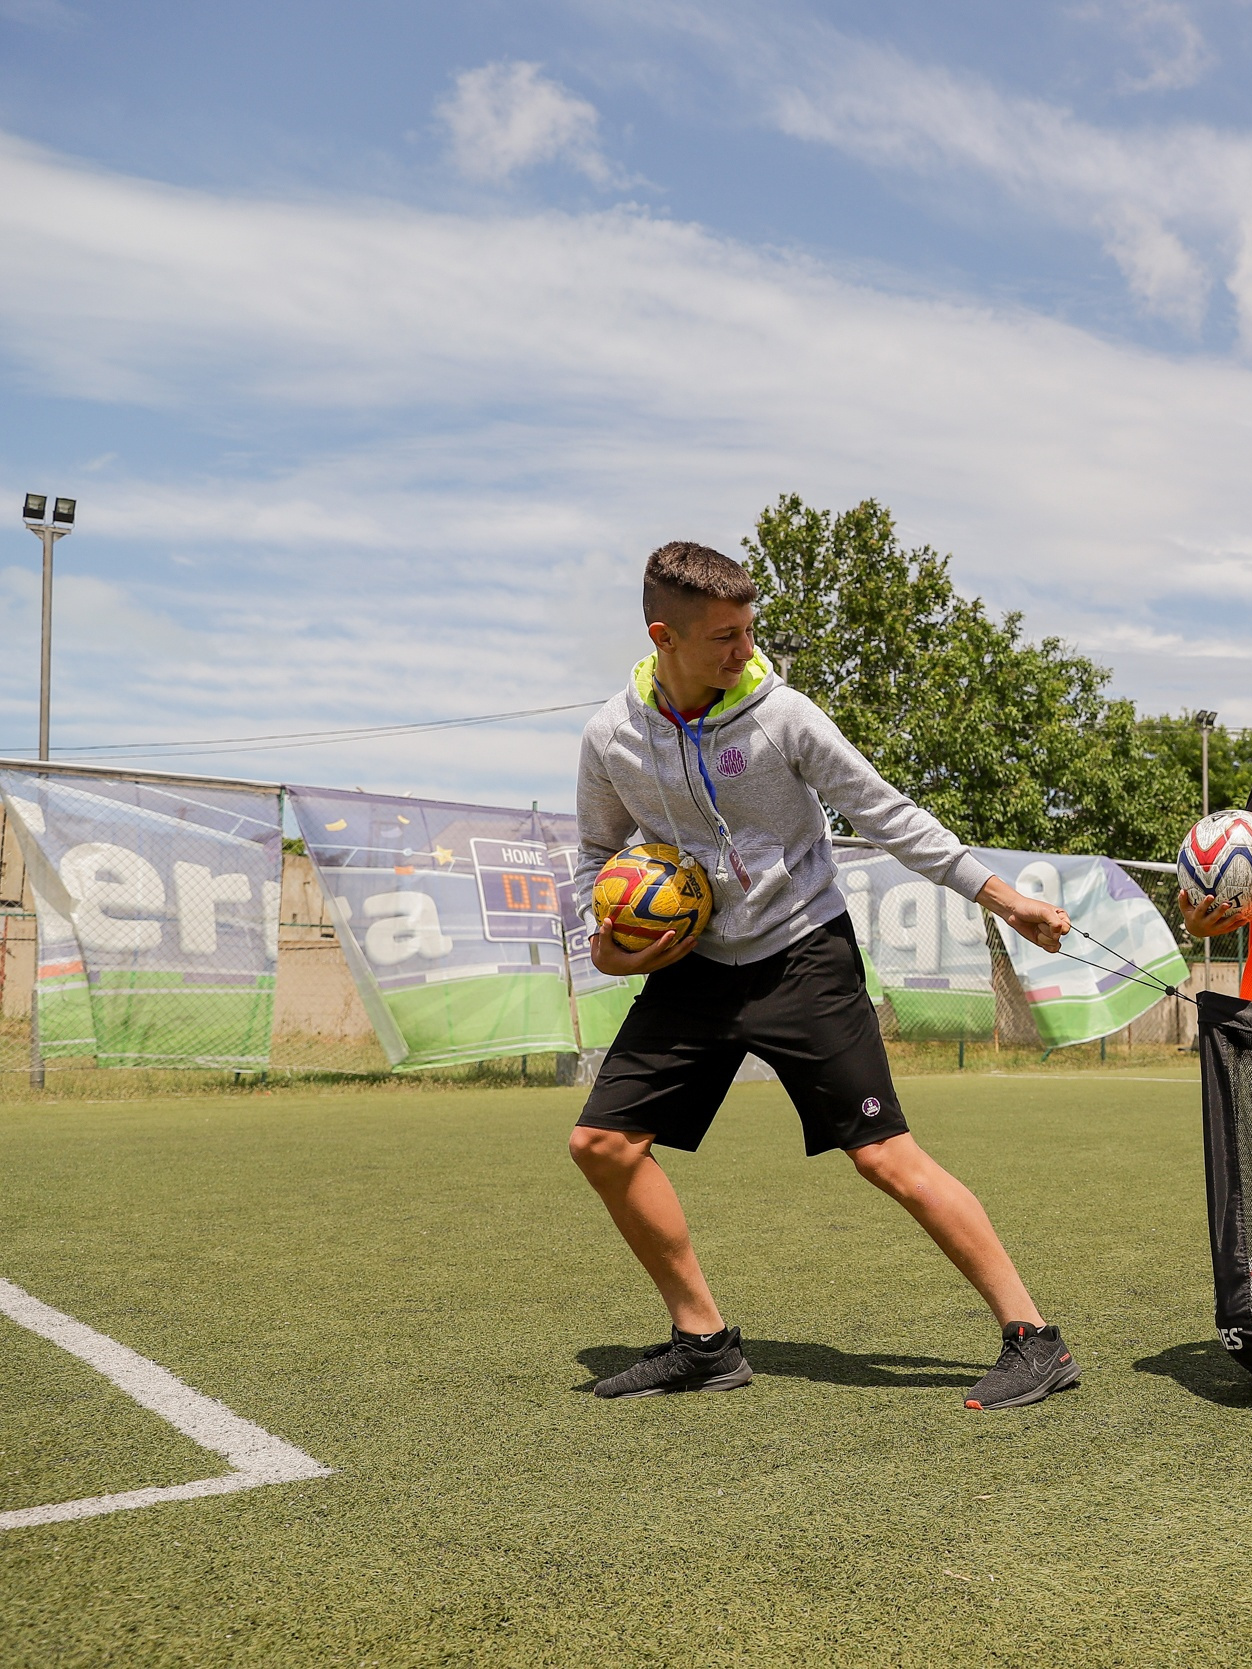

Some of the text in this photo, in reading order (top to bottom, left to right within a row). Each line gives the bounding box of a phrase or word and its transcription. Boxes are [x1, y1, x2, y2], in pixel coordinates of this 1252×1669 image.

[720, 749, 742, 764] TERRA
[501, 847, 545, 867] HOME
[501, 873, 559, 912] 03
[685, 872, 703, 900] PEAK
